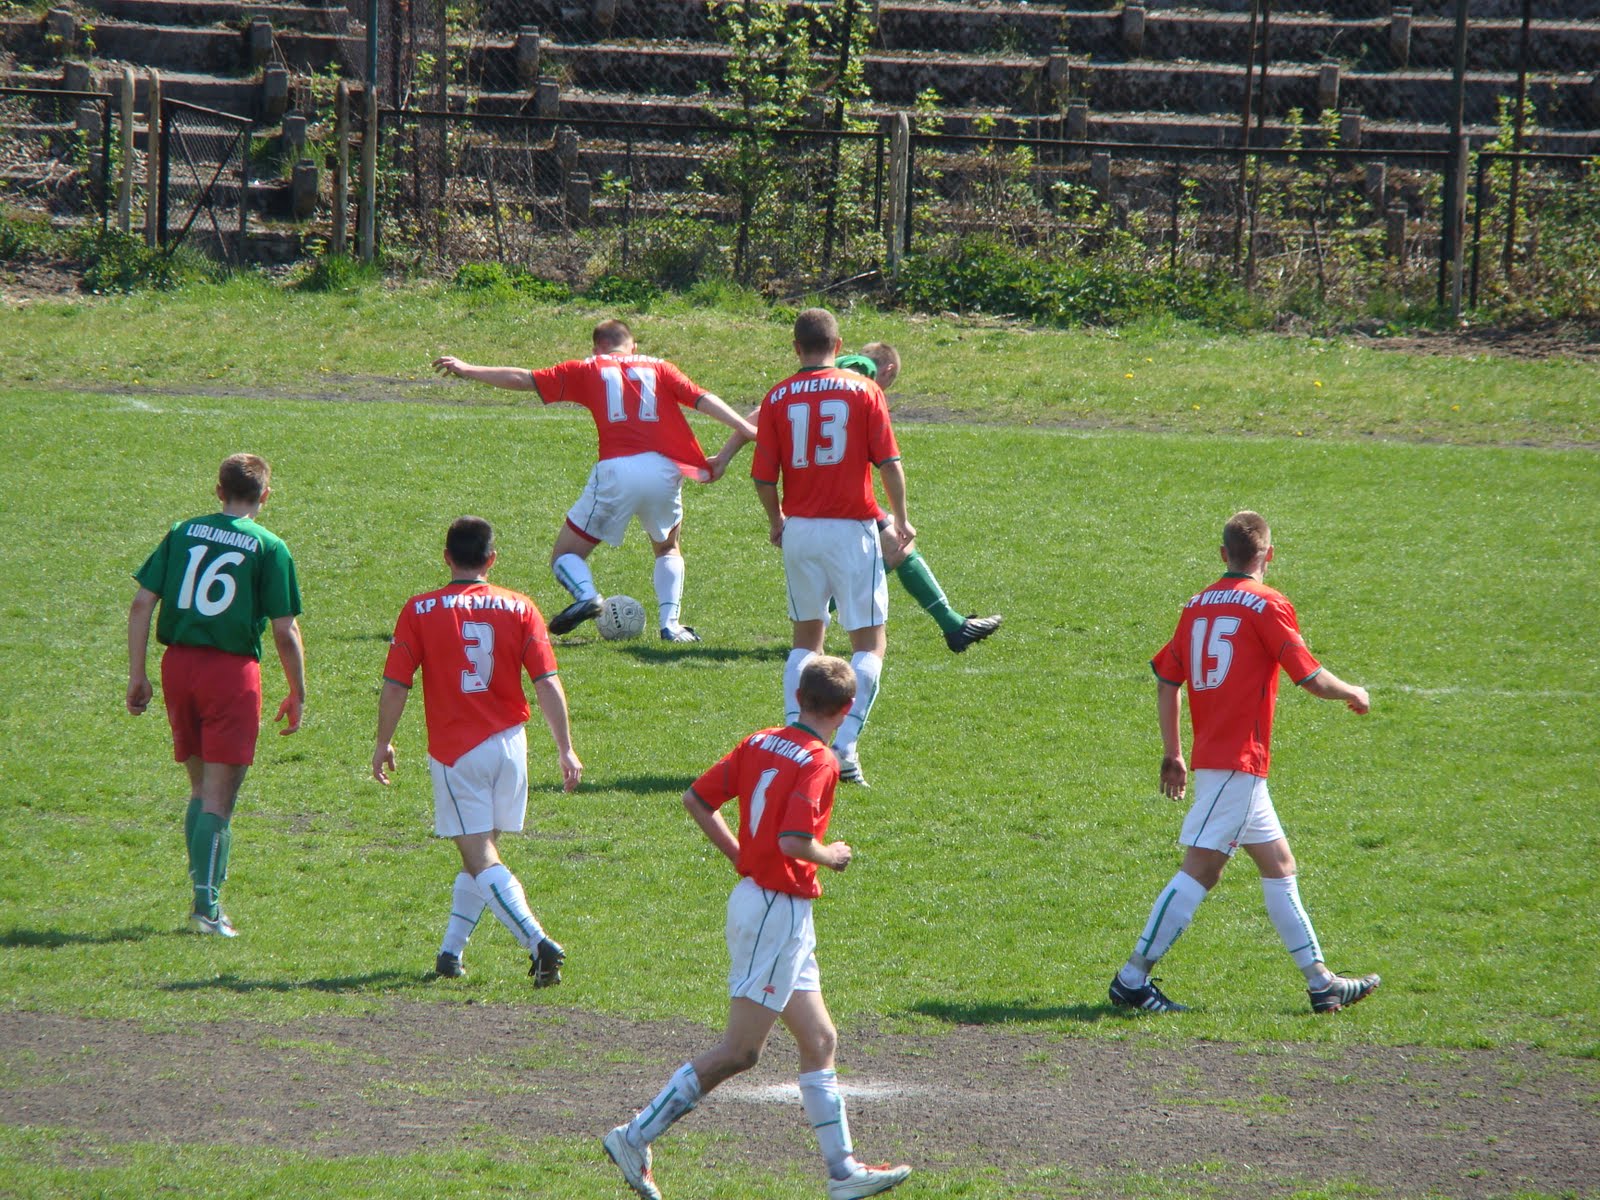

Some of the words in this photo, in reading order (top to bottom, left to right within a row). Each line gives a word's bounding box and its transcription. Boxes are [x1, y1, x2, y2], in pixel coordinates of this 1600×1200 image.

[601, 366, 659, 423] 17
[770, 386, 787, 404] KP
[788, 399, 849, 469] 13
[186, 523, 258, 552] LUBLINIANKA
[177, 544, 246, 616] 16
[415, 598, 437, 615] KP
[1201, 589, 1268, 614] WIENIAWA
[461, 621, 495, 694] 3
[1190, 616, 1242, 692] 15
[749, 768, 780, 840] 1
